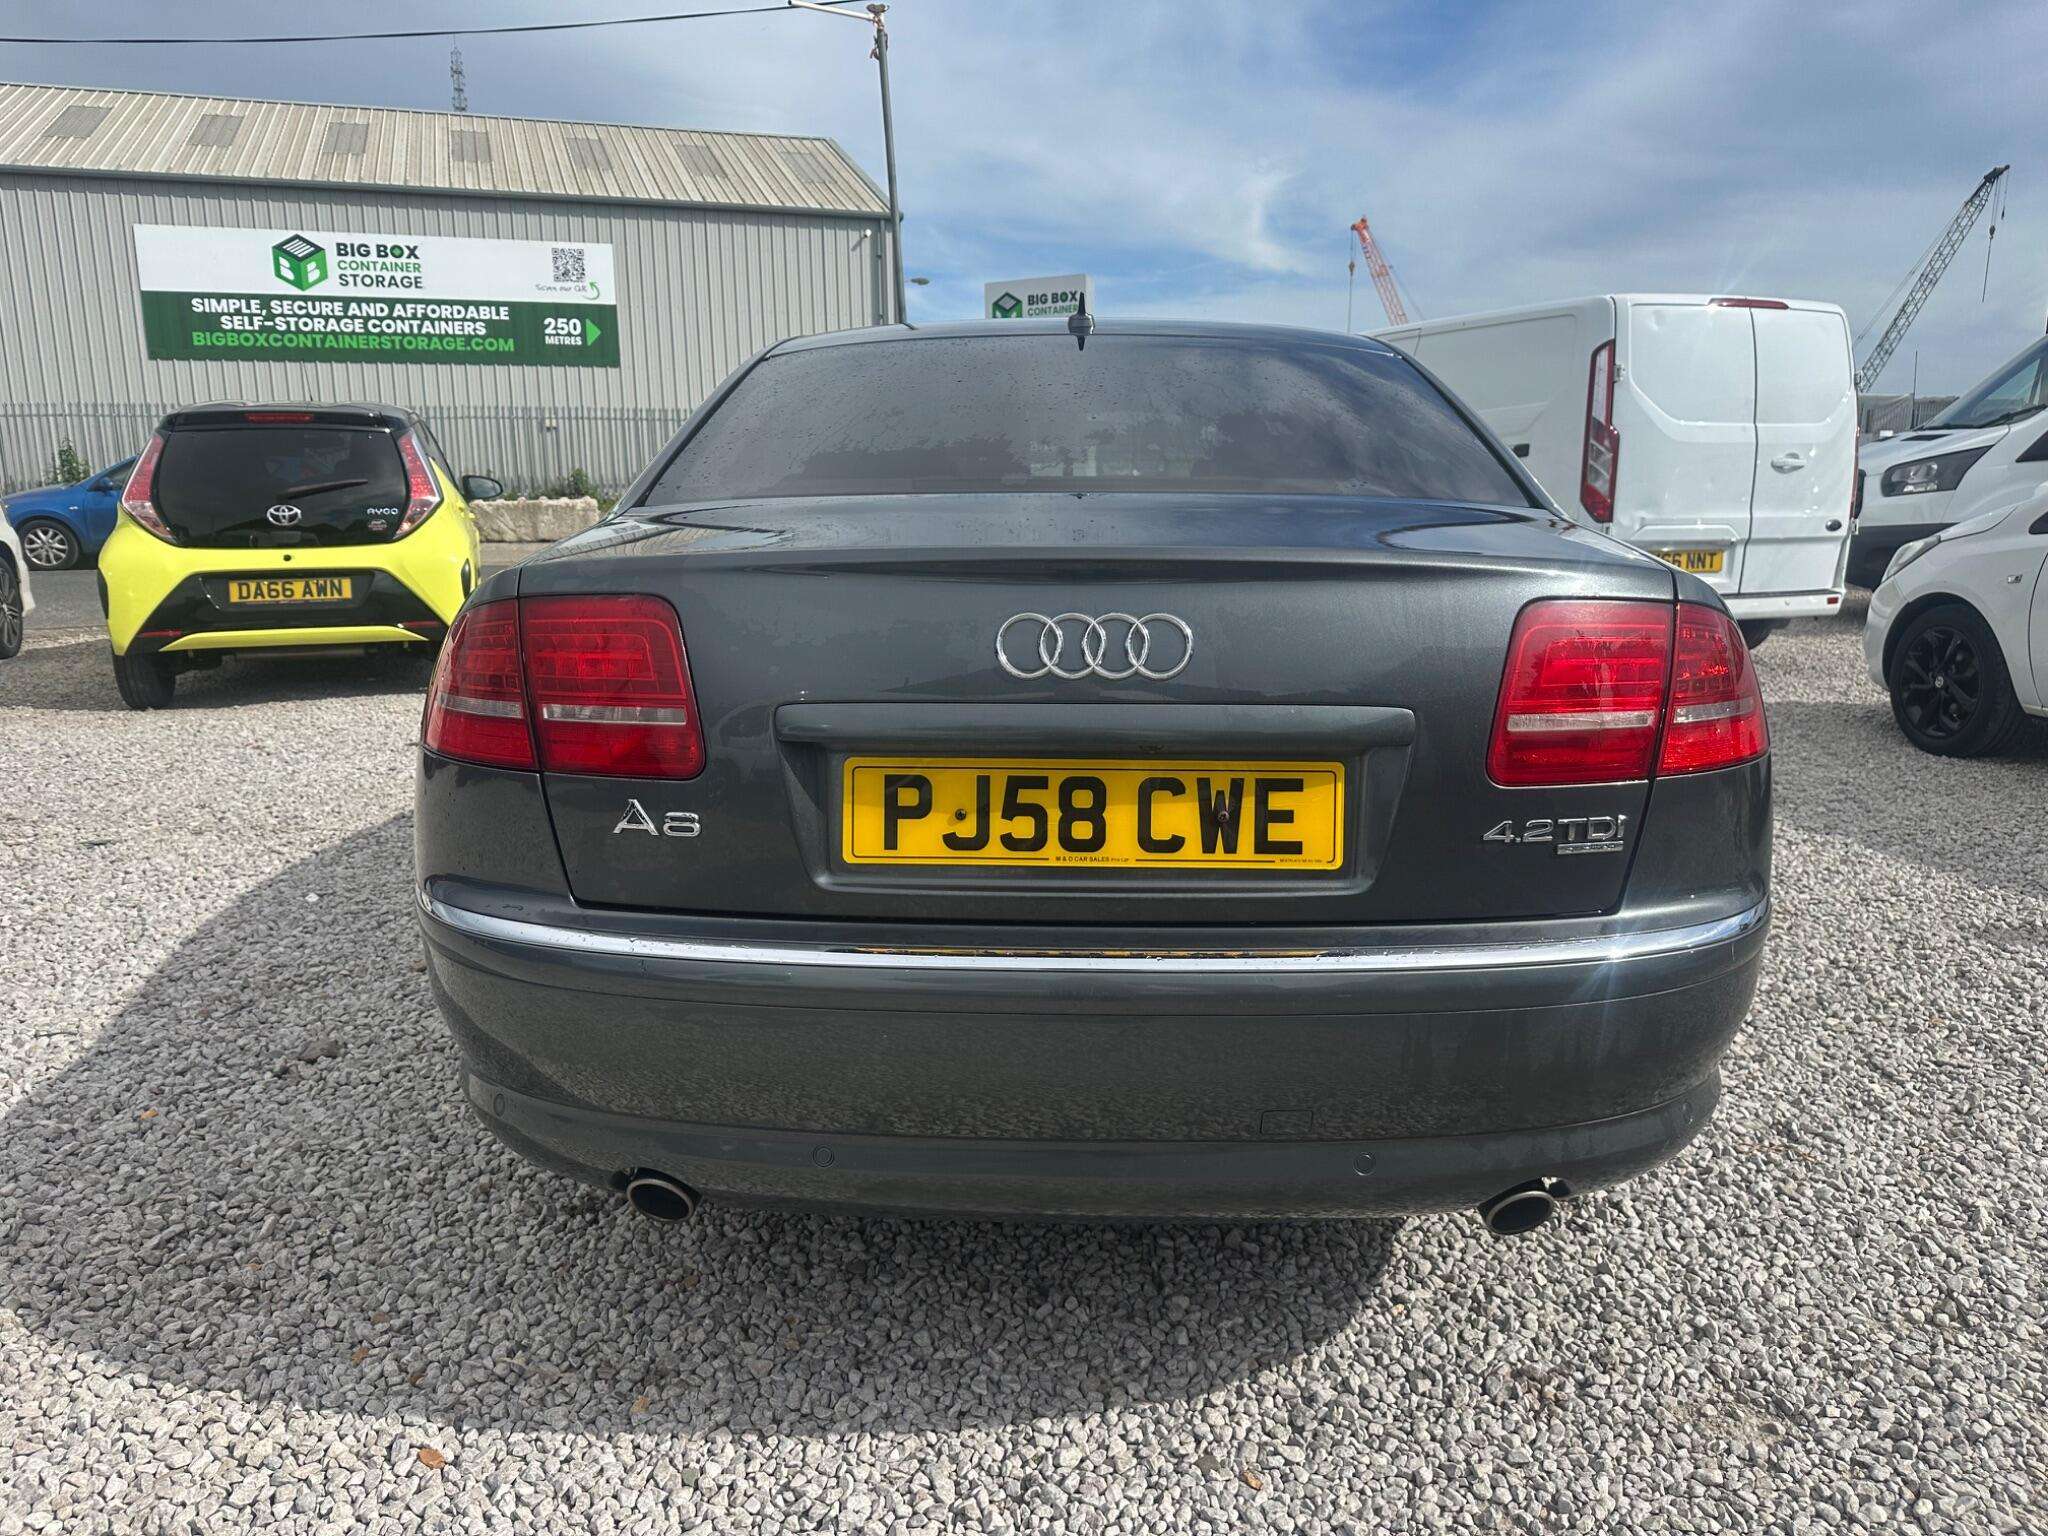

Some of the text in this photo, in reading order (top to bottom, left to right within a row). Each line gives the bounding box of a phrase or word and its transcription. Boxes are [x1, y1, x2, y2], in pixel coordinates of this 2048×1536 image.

[336, 242, 420, 259] BIG BOX
[337, 260, 421, 273] CONTAINER
[339, 274, 423, 289] STORAGE
[1027, 290, 1078, 306] BIG BOX
[191, 298, 510, 320] SIMPLE, SECURE AND AFFORDABLE
[1027, 303, 1079, 316] CONTAINER
[220, 315, 487, 335] SELF-STORAGE CONTAINERS
[543, 317, 582, 335] 250
[191, 331, 515, 352] BIGBOXCONTAINERSTORAGE.COM
[545, 335, 582, 345] METRES
[1686, 552, 1717, 569] NNT
[238, 579, 343, 600] DA66 AWN
[613, 799, 701, 837] A8
[883, 774, 1305, 855] PJ58 CWE
[1483, 820, 1554, 842] 4.2
